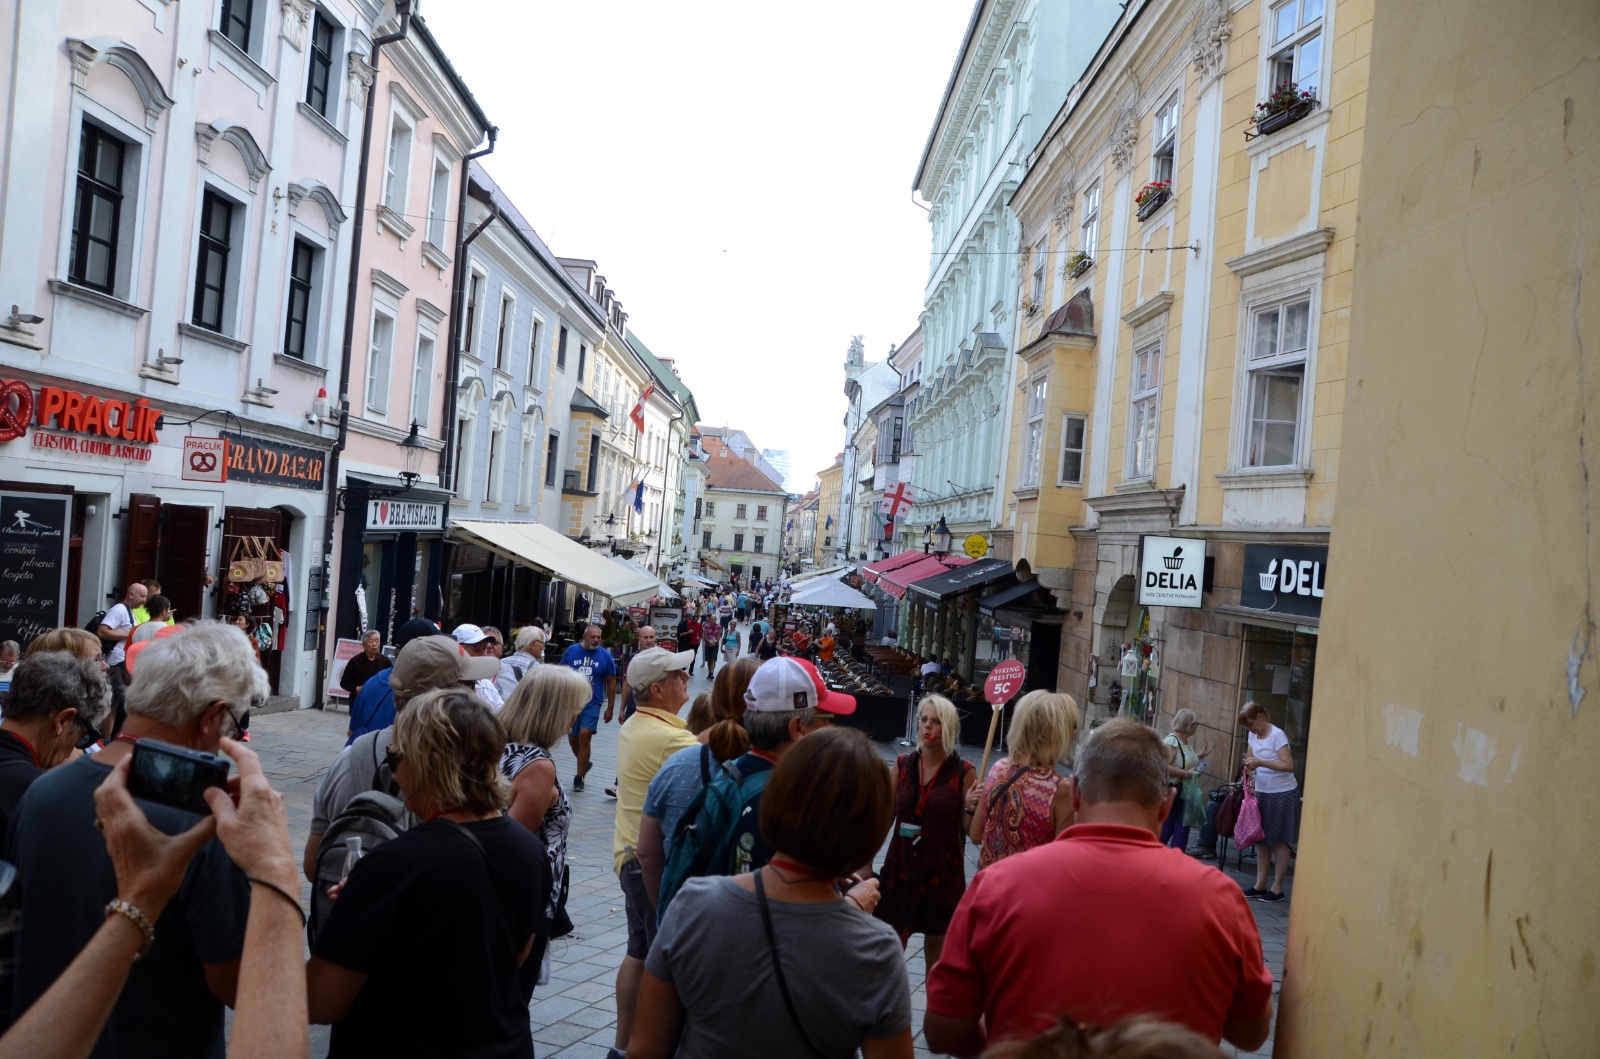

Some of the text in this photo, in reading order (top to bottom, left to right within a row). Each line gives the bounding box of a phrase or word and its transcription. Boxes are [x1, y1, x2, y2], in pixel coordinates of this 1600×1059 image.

[38, 387, 163, 443] PRACLÍK
[186, 440, 222, 450] PRACLÍK
[278, 452, 323, 481] BAZAR
[372, 502, 437, 525] I BRATISLAVA
[1145, 571, 1197, 590] DELIA
[1280, 558, 1325, 598] DEL
[40, 600, 53, 609] go
[989, 672, 1022, 681] PRESTIGE
[994, 666, 1020, 674] VIKING
[993, 682, 1011, 694] 5C
